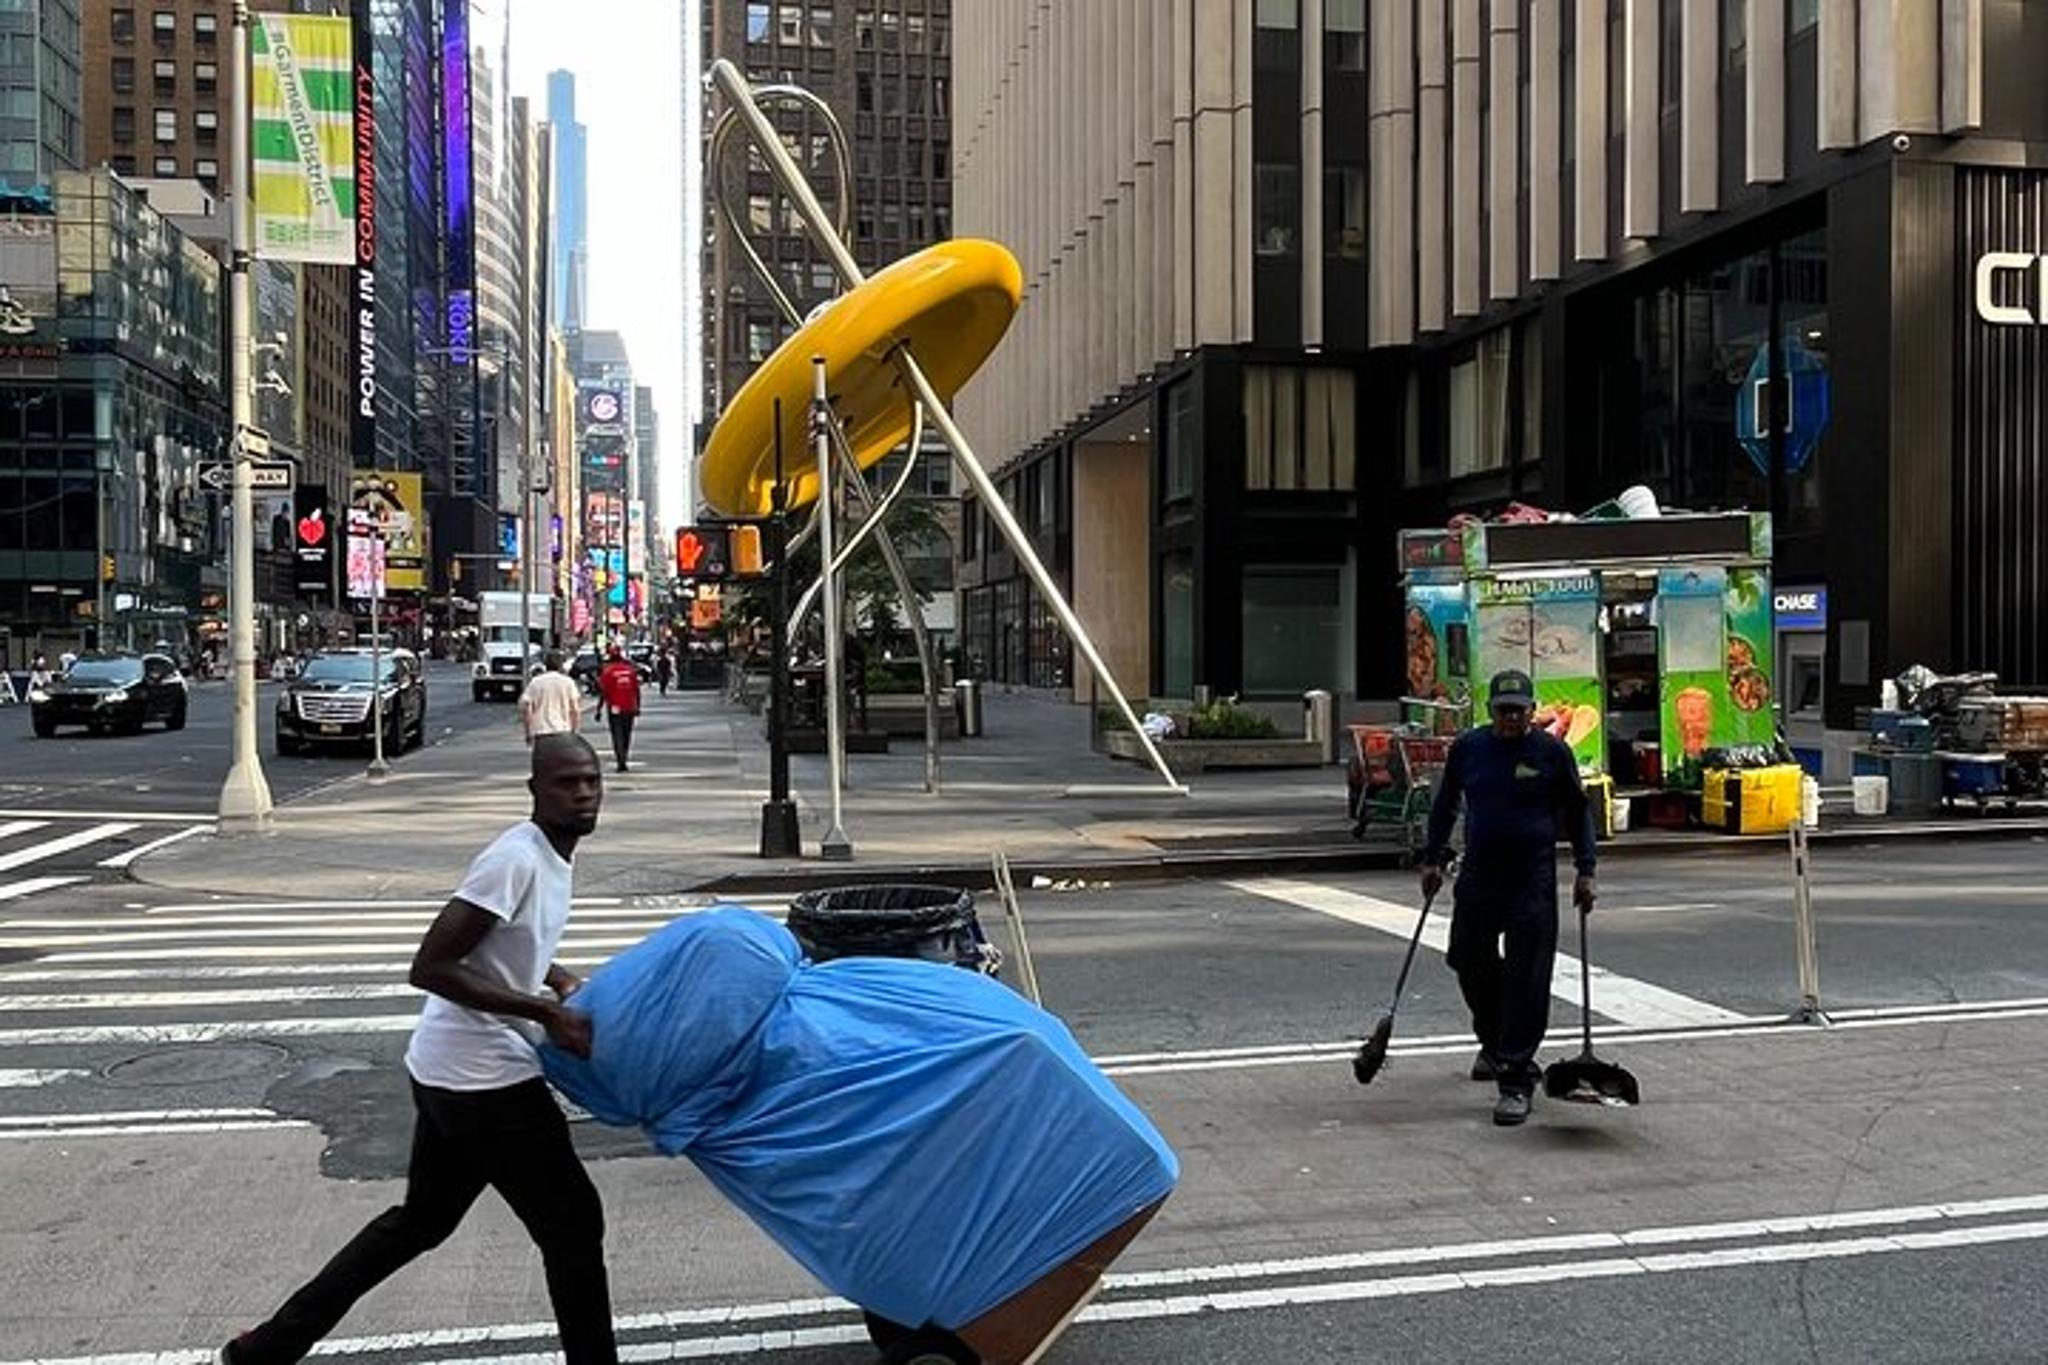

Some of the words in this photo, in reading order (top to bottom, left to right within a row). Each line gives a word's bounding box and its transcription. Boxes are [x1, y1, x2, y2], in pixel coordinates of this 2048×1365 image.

[271, 32, 331, 206] #GarmentDistrict
[358, 63, 374, 262] COMMUNITY
[359, 268, 375, 302] IN
[1976, 252, 2048, 325] C
[360, 309, 375, 418] POWER
[209, 471, 234, 483] ON
[1774, 593, 1818, 611] CHASE
